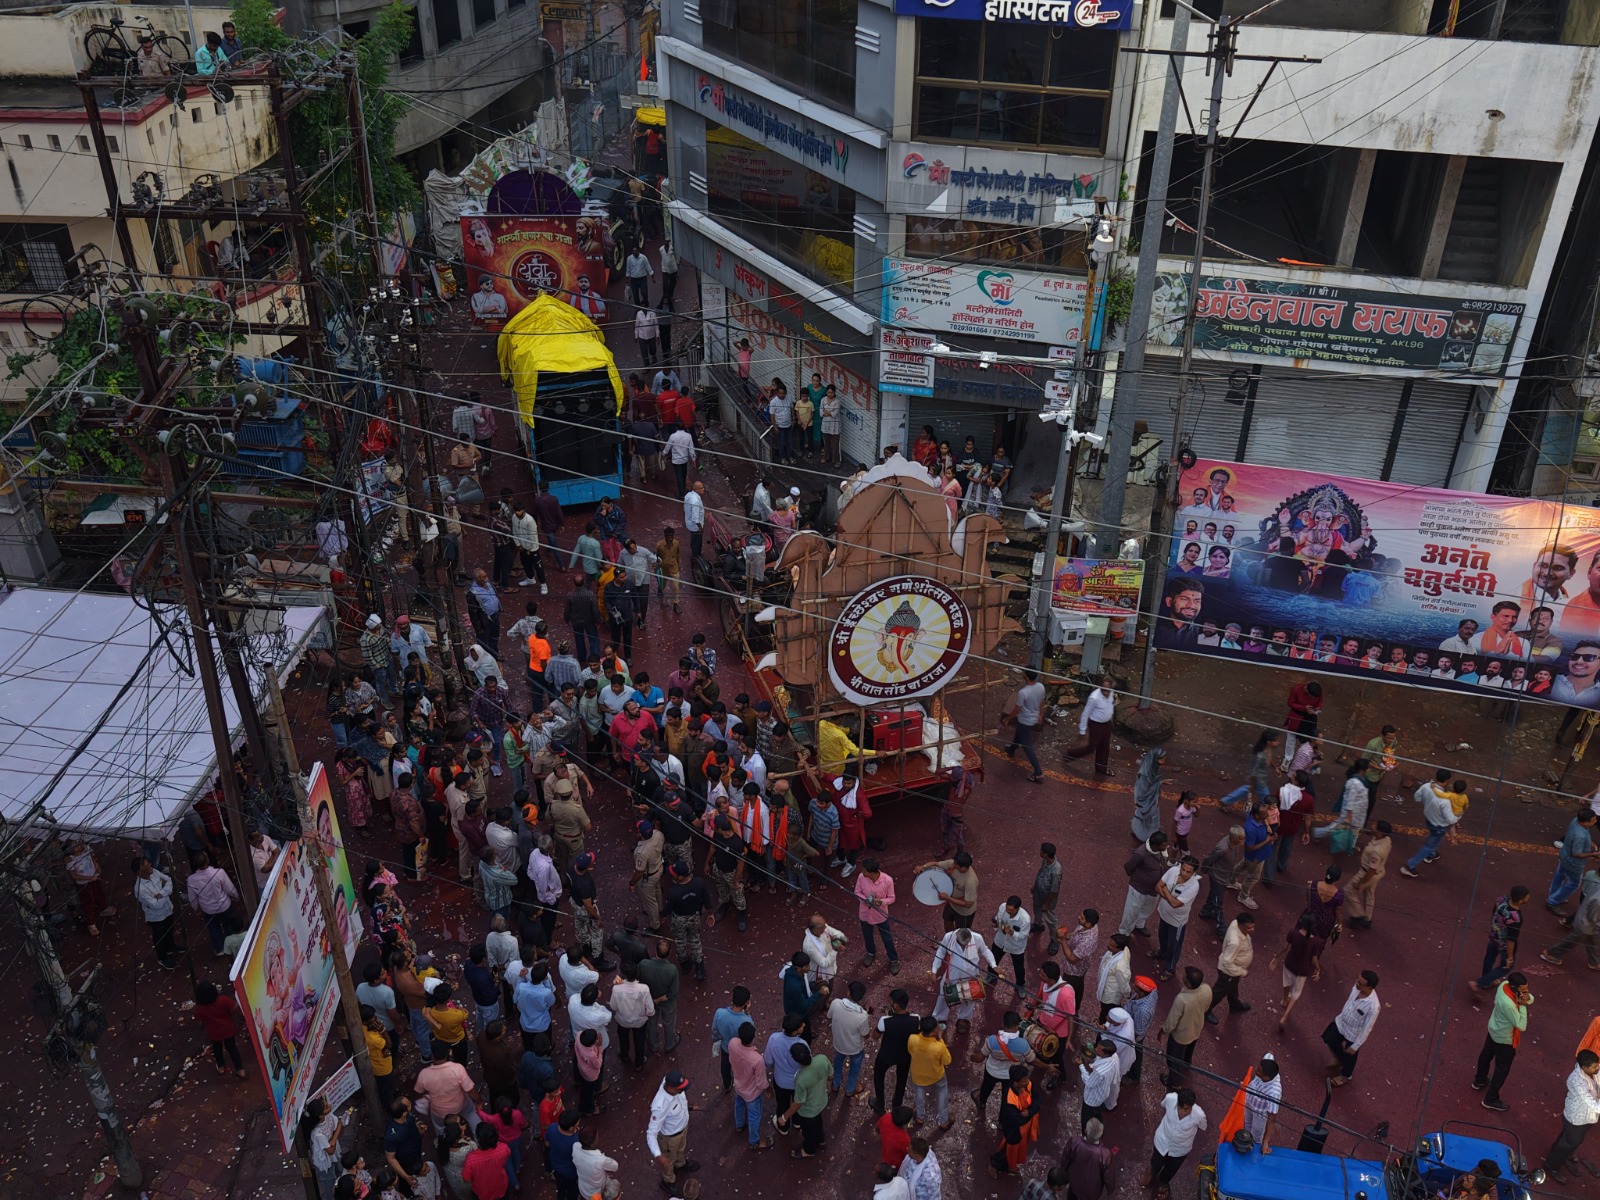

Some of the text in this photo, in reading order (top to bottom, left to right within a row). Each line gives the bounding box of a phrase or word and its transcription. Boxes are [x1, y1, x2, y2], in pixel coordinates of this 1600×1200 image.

[541, 4, 585, 18] Cement
[734, 263, 766, 297] अंकुश
[1196, 279, 1453, 339] खंडेलवाल सराफ
[1019, 320, 1035, 330] होम
[1390, 340, 1424, 349] AKL96
[1420, 543, 1491, 571] अनंत
[1403, 567, 1498, 598] चतुर्दशी
[835, 630, 850, 645] श्री
[889, 578, 952, 605] गणेशोत्सव
[948, 601, 964, 628] मंडळ
[850, 662, 947, 695] श्री लाल सोंड चा राजा
